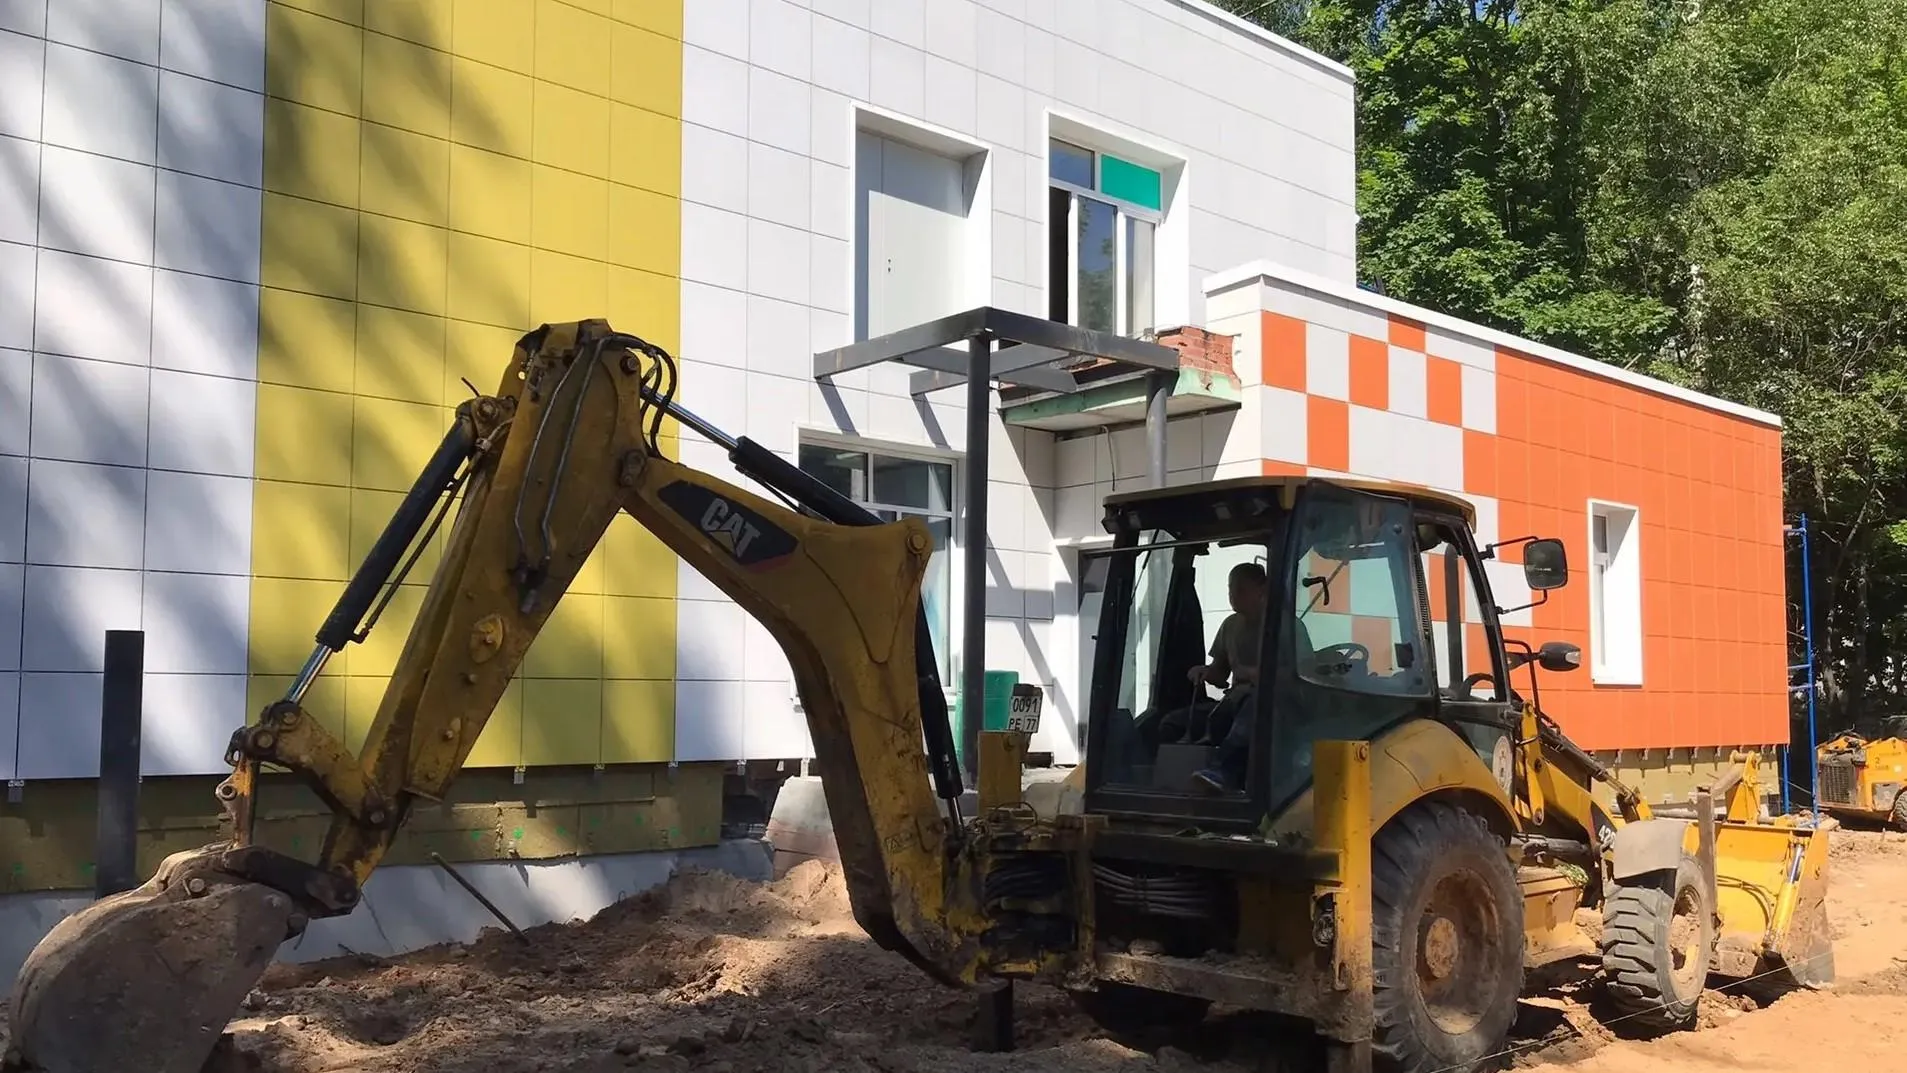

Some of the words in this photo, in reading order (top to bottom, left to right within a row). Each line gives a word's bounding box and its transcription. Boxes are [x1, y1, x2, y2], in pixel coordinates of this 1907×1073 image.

[701, 498, 760, 558] CAT
[1013, 698, 1038, 712] 0091
[1026, 718, 1037, 730] 77
